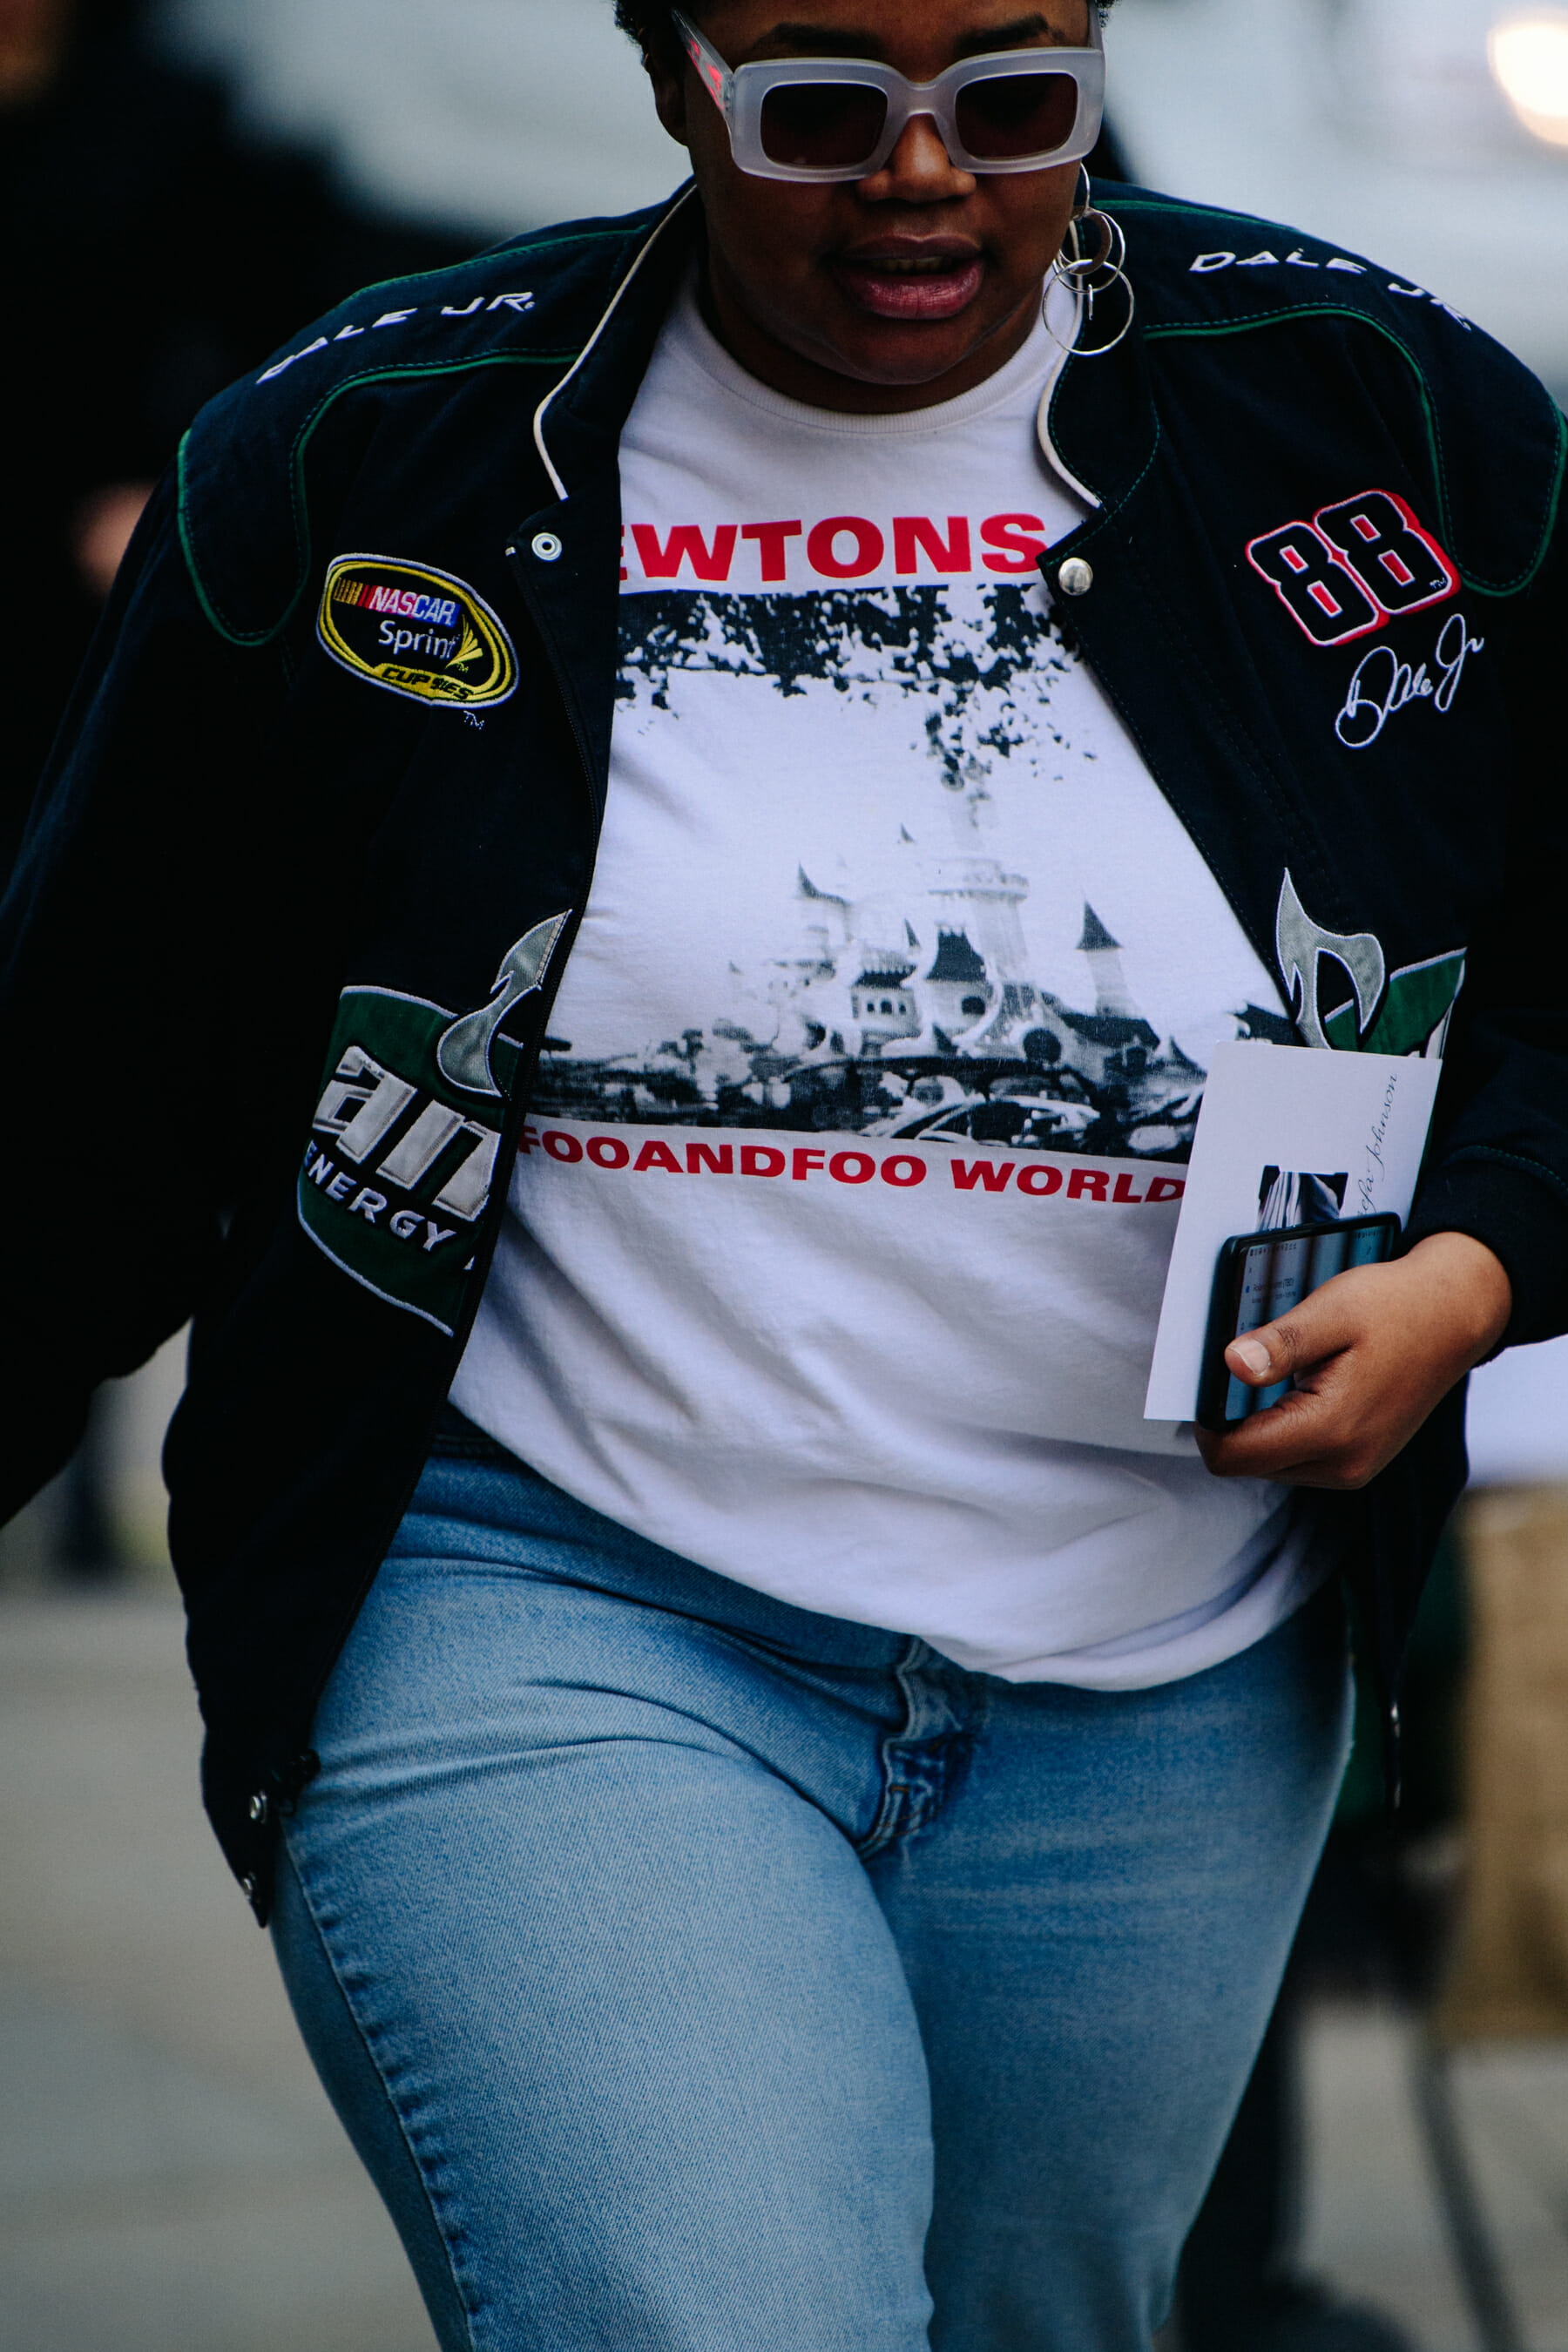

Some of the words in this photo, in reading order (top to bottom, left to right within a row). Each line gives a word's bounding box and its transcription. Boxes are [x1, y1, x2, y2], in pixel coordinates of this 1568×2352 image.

[1189, 247, 1368, 275] DALE
[255, 307, 418, 384] DALE
[619, 512, 1049, 583] WTONS
[1245, 487, 1462, 647] 88
[368, 585, 457, 626] NASCAR
[382, 666, 432, 686] CUP
[518, 1125, 928, 1187] FOOANDFOO
[950, 1159, 1186, 1204] WORLD
[1365, 1072, 1398, 1182] Johnson
[304, 1139, 458, 1252] ENERGY
